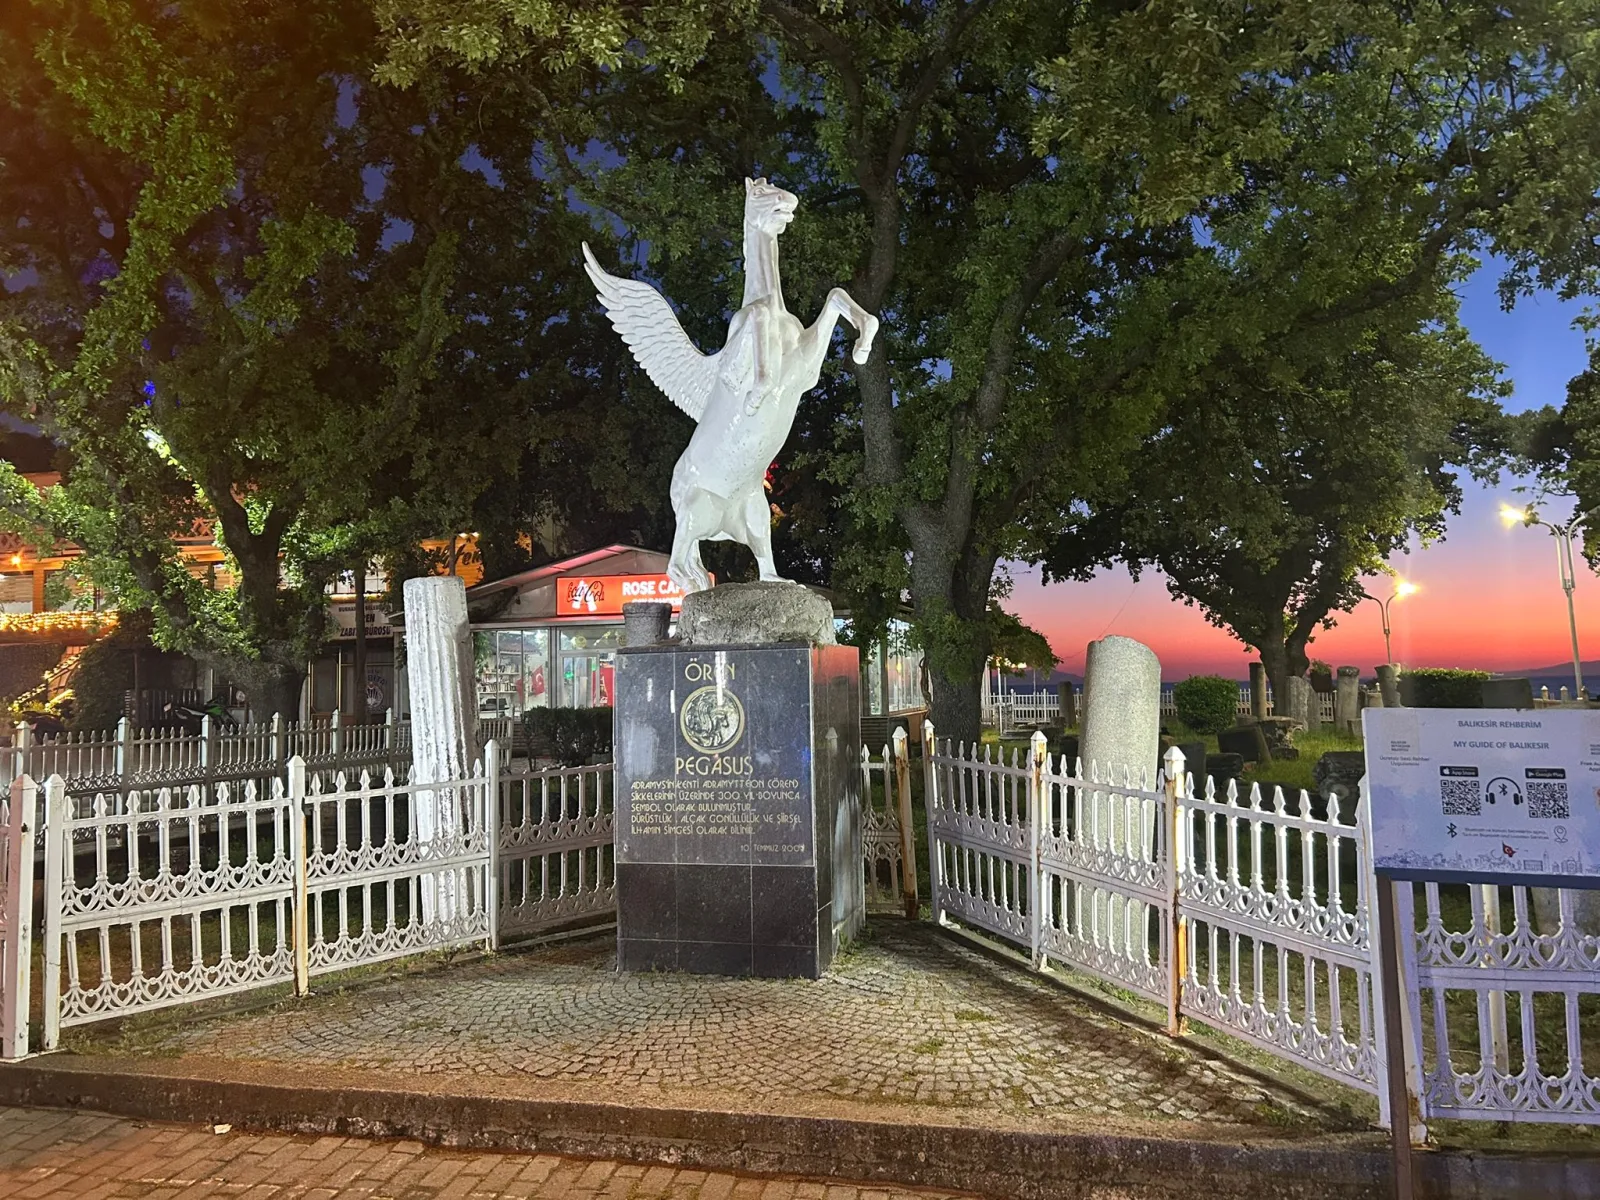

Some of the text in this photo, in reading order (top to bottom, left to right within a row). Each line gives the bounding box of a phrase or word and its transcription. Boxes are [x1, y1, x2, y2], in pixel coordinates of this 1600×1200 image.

[622, 580, 656, 596] ROSE
[685, 657, 735, 681] ÖRN
[1458, 719, 1542, 729] BALIKESİR REHBERİM
[1469, 741, 1494, 749] GUIDE
[1509, 742, 1550, 750] BALIKESIR
[675, 755, 753, 775] PEGASUS
[767, 777, 799, 789] (ÖREN)
[678, 789, 715, 800] ÜZERİNDE
[631, 803, 662, 812] SEMBOL
[664, 803, 696, 812] OLARAK
[631, 813, 673, 824] DÜRÜSTLÜK
[680, 814, 706, 825] ALÇAK
[762, 813, 774, 823] VE
[663, 824, 694, 835] SİMGESİ
[696, 825, 728, 835] OLARAK
[753, 843, 780, 852] TEMMUZ
